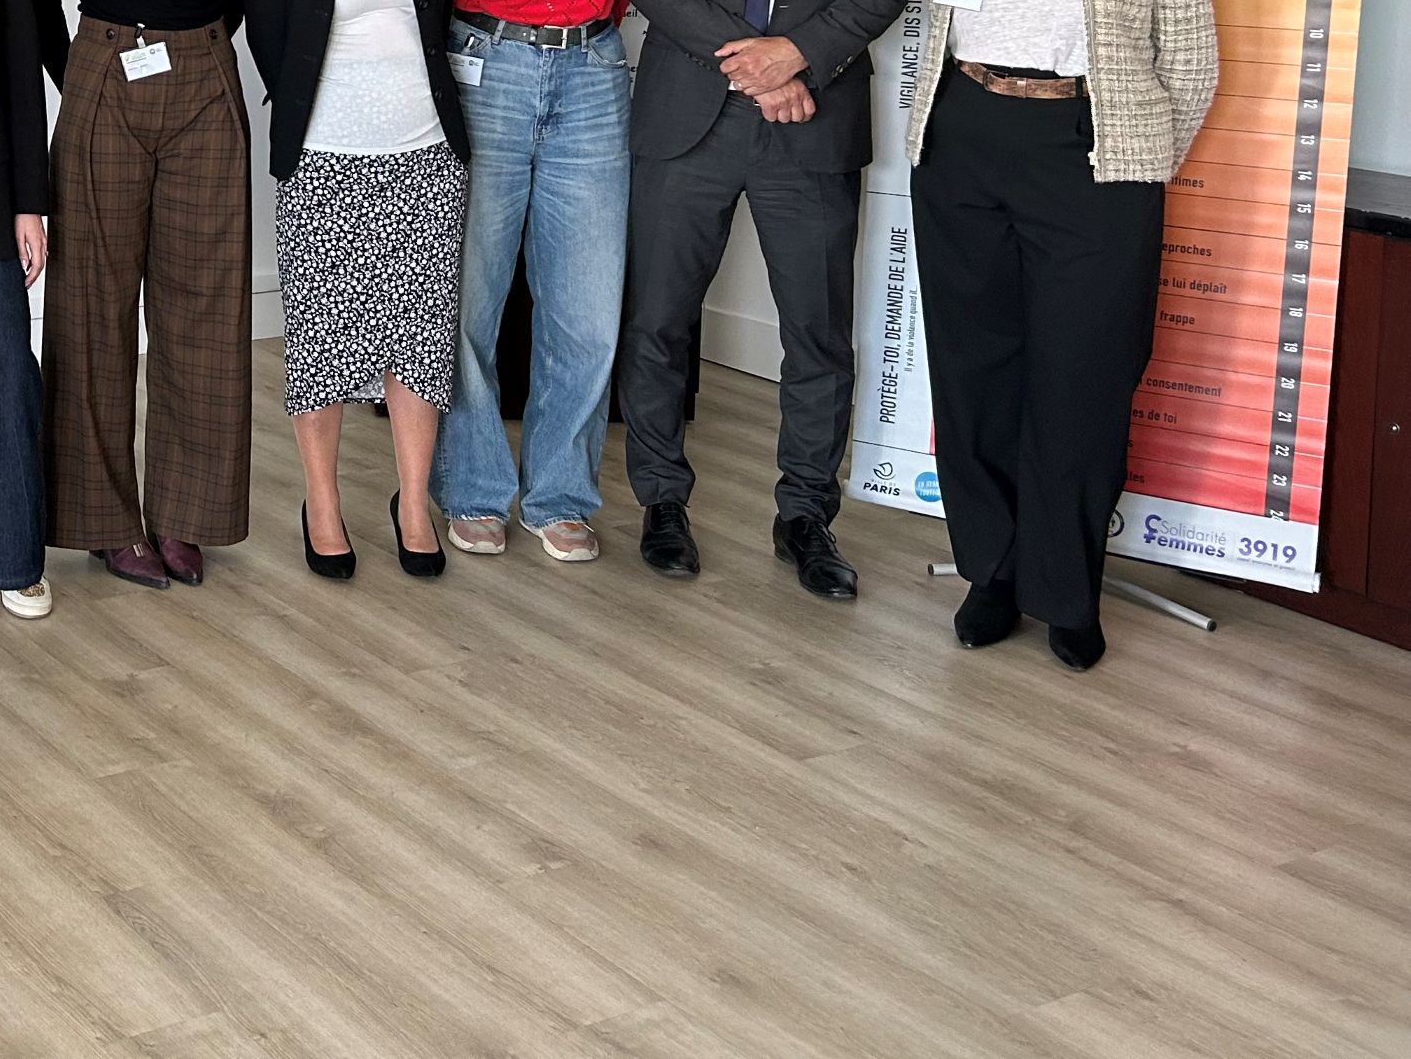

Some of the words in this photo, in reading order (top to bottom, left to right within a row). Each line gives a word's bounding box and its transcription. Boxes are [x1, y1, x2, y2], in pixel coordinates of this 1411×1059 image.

[904, 17, 921, 38] DIS
[1309, 28, 1325, 39] 10
[1305, 62, 1321, 72] 11
[899, 42, 920, 110] VIGILANCE,
[1303, 98, 1318, 110] 12
[1300, 134, 1315, 146] 13
[1297, 170, 1312, 181] 14
[1296, 204, 1311, 214] 15
[889, 226, 908, 264] L'AIDE
[1161, 242, 1213, 257] eproches
[1294, 240, 1309, 250] 16
[889, 264, 905, 282] DE
[1291, 274, 1307, 284] 17
[1172, 278, 1186, 289] lui
[1189, 279, 1227, 294] déplaît
[909, 295, 918, 314] quand
[885, 283, 904, 342] DEMANDE
[1159, 310, 1195, 326] frappe
[1289, 307, 1303, 318] 18
[907, 315, 915, 340] violence
[1283, 342, 1299, 353] 19
[878, 344, 901, 424] PROTÈGE-TOI,
[1146, 376, 1222, 398] consentement
[1281, 378, 1295, 390] 20
[1147, 409, 1161, 421] de
[1163, 413, 1177, 424] toi
[1278, 412, 1293, 422] 21
[1275, 444, 1290, 457] 22
[1272, 474, 1287, 486] 23
[863, 482, 901, 496] PARIS
[1160, 520, 1227, 546] Solidarité
[1239, 537, 1297, 564] 3919
